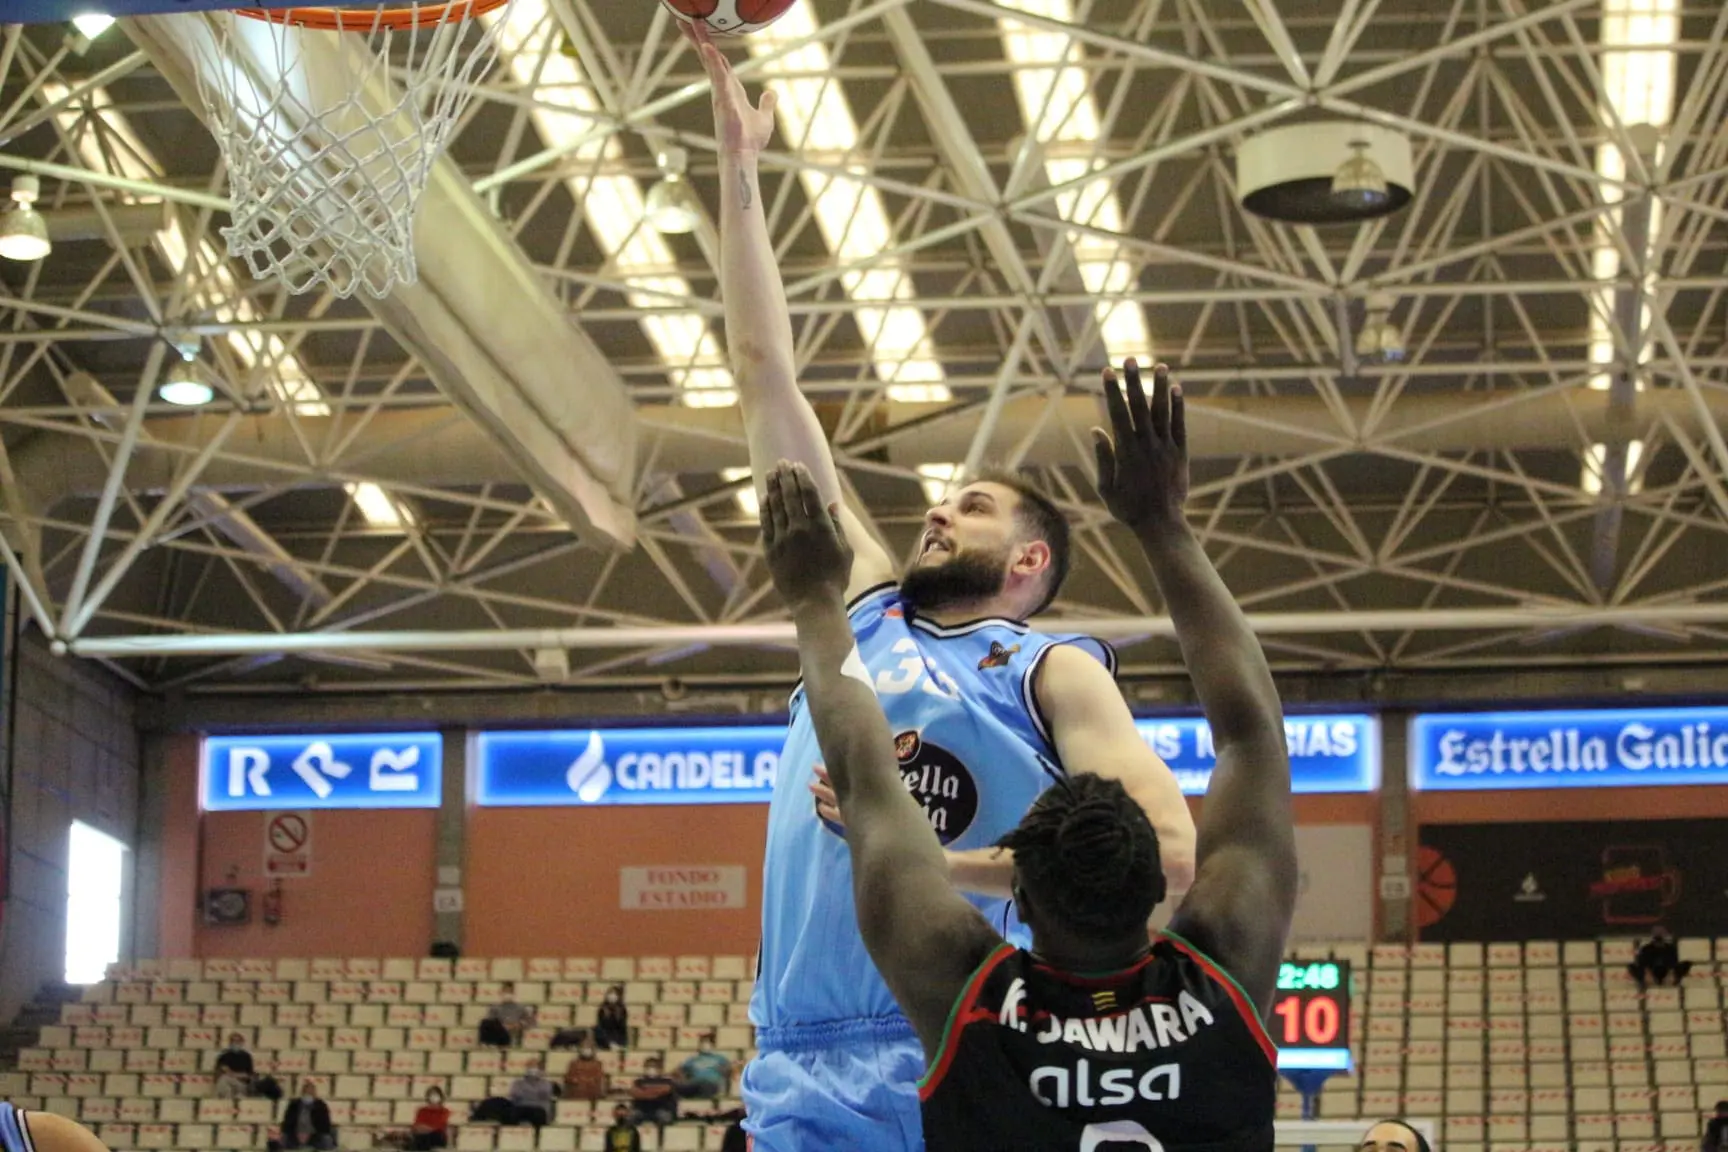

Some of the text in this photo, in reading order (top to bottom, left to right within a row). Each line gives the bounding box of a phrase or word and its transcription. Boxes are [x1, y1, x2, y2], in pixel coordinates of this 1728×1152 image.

[616, 750, 779, 790] CANDELA
[1435, 728, 1608, 776] Estrella
[900, 765, 959, 800] ella
[639, 889, 728, 905] ESTADIO
[1000, 977, 1214, 1053] K. JAWARA
[1275, 996, 1339, 1044] 10
[1030, 1058, 1181, 1108] alsa
